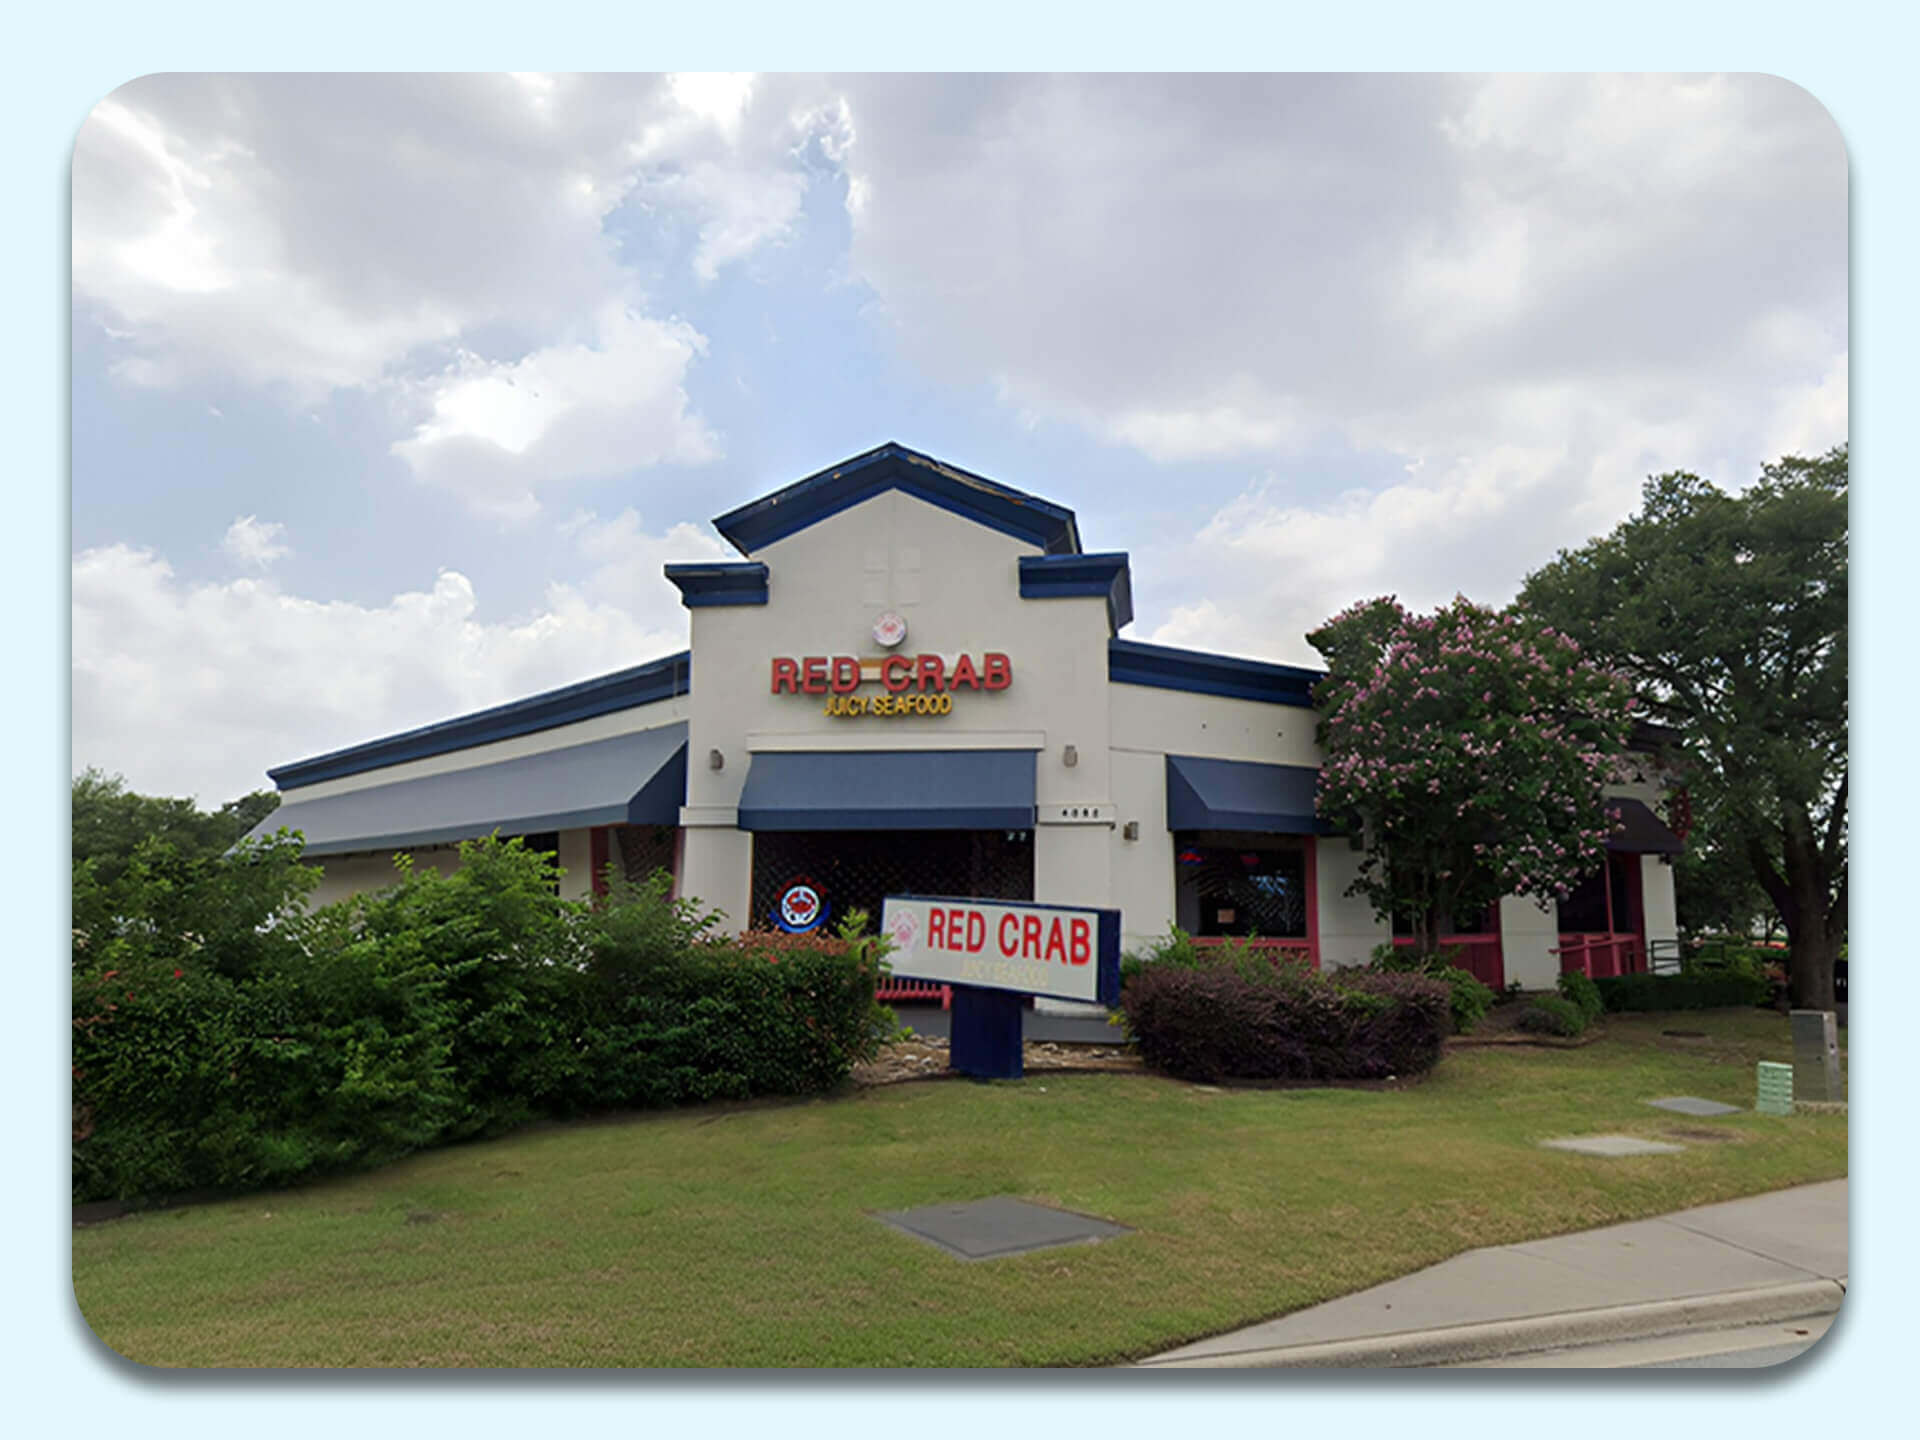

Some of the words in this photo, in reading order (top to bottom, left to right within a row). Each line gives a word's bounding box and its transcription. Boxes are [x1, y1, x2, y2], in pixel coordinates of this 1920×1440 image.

[771, 657, 861, 694] RED
[881, 652, 1013, 692] CRAB
[823, 696, 870, 716] JUICY
[874, 693, 952, 715] SEAFOOD
[927, 907, 987, 953] RED
[998, 912, 1092, 966] CRAB
